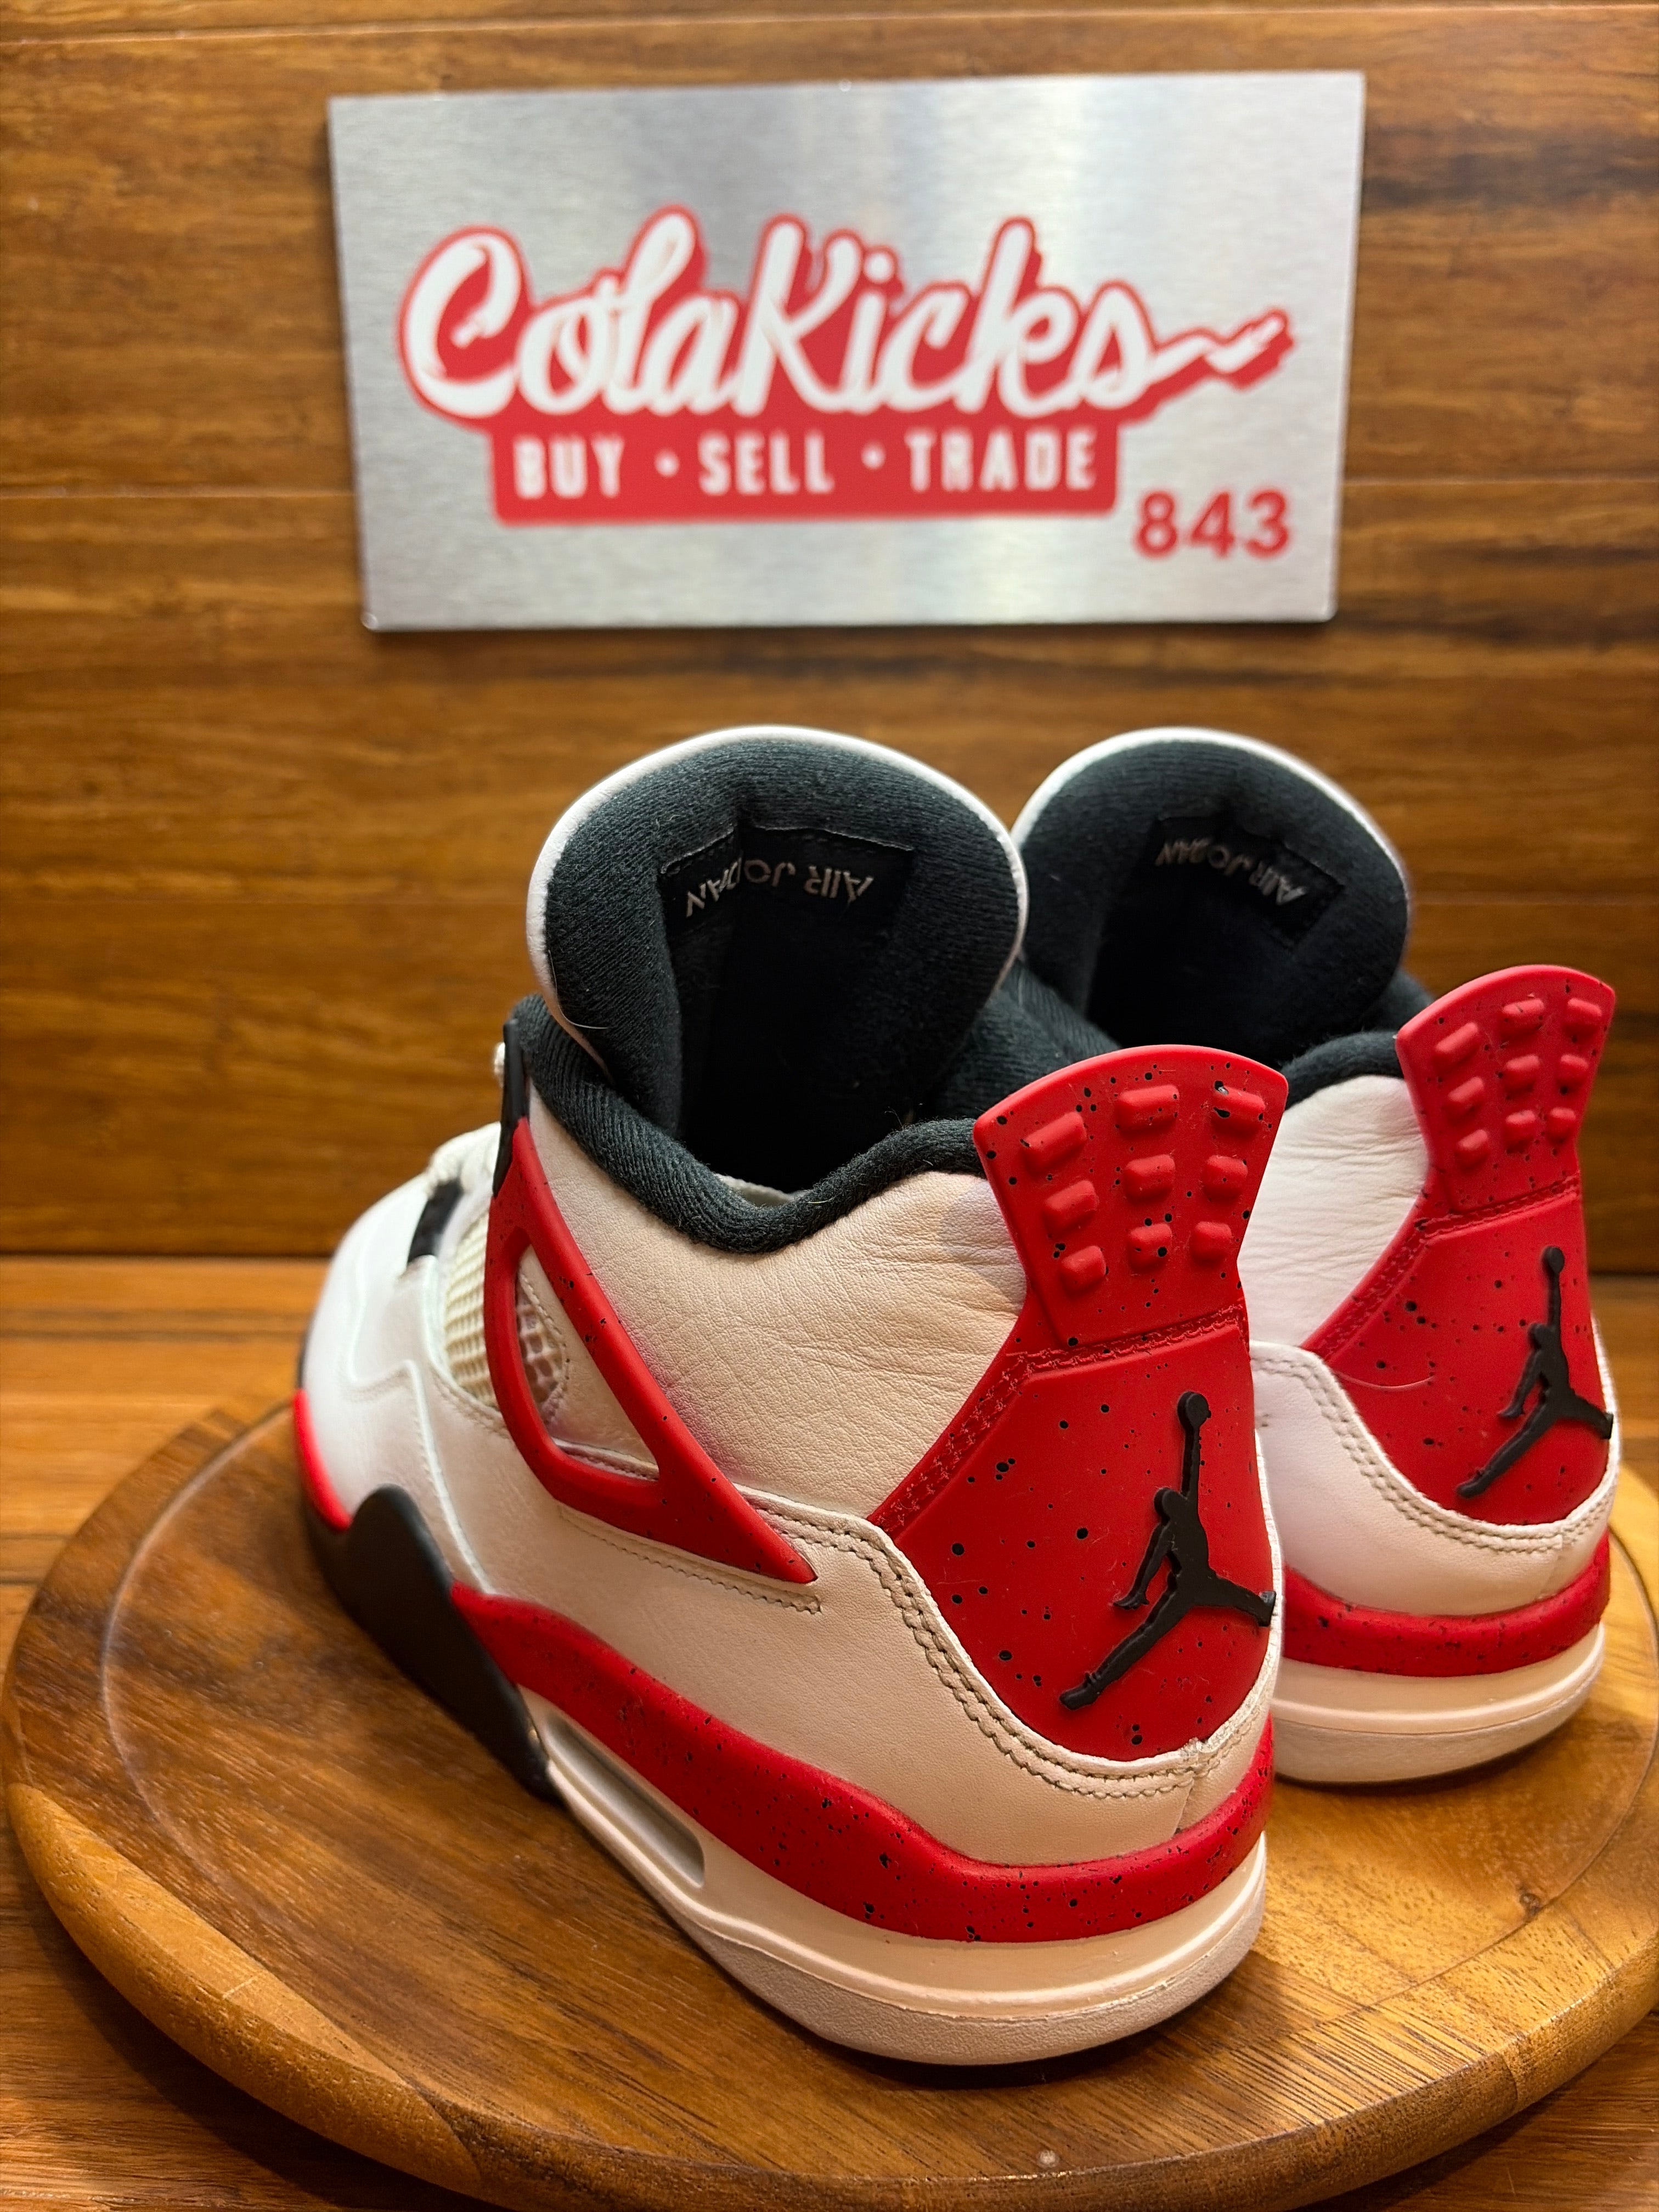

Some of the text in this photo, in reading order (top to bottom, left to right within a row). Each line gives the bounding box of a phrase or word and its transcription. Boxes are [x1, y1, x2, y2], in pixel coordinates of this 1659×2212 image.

[399, 205, 1292, 420] ColaKicks
[513, 430, 1096, 498] BUY SELL TRADE
[1136, 490, 1289, 560] 843
[686, 855, 874, 917] AIR JODAN
[1154, 837, 1253, 877] JODAN
